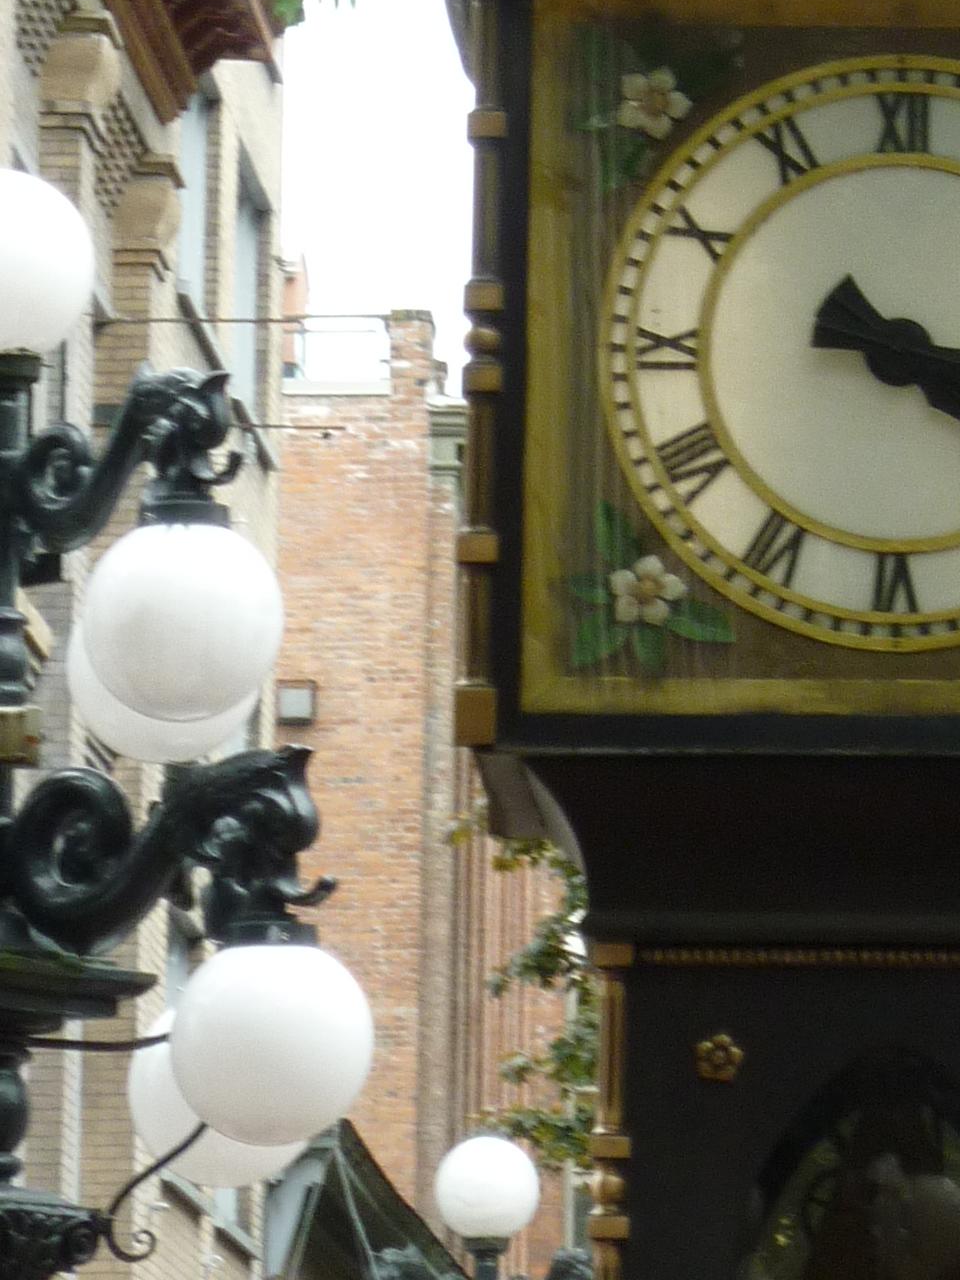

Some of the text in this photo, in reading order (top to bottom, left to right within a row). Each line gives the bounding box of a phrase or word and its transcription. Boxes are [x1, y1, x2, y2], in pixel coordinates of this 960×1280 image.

[754, 116, 820, 185] XI
[878, 92, 929, 153] XII
[667, 205, 734, 262] X
[637, 326, 697, 371] IX
[655, 422, 730, 504] VIII
[743, 509, 805, 588] VII
[872, 553, 917, 613] VI
